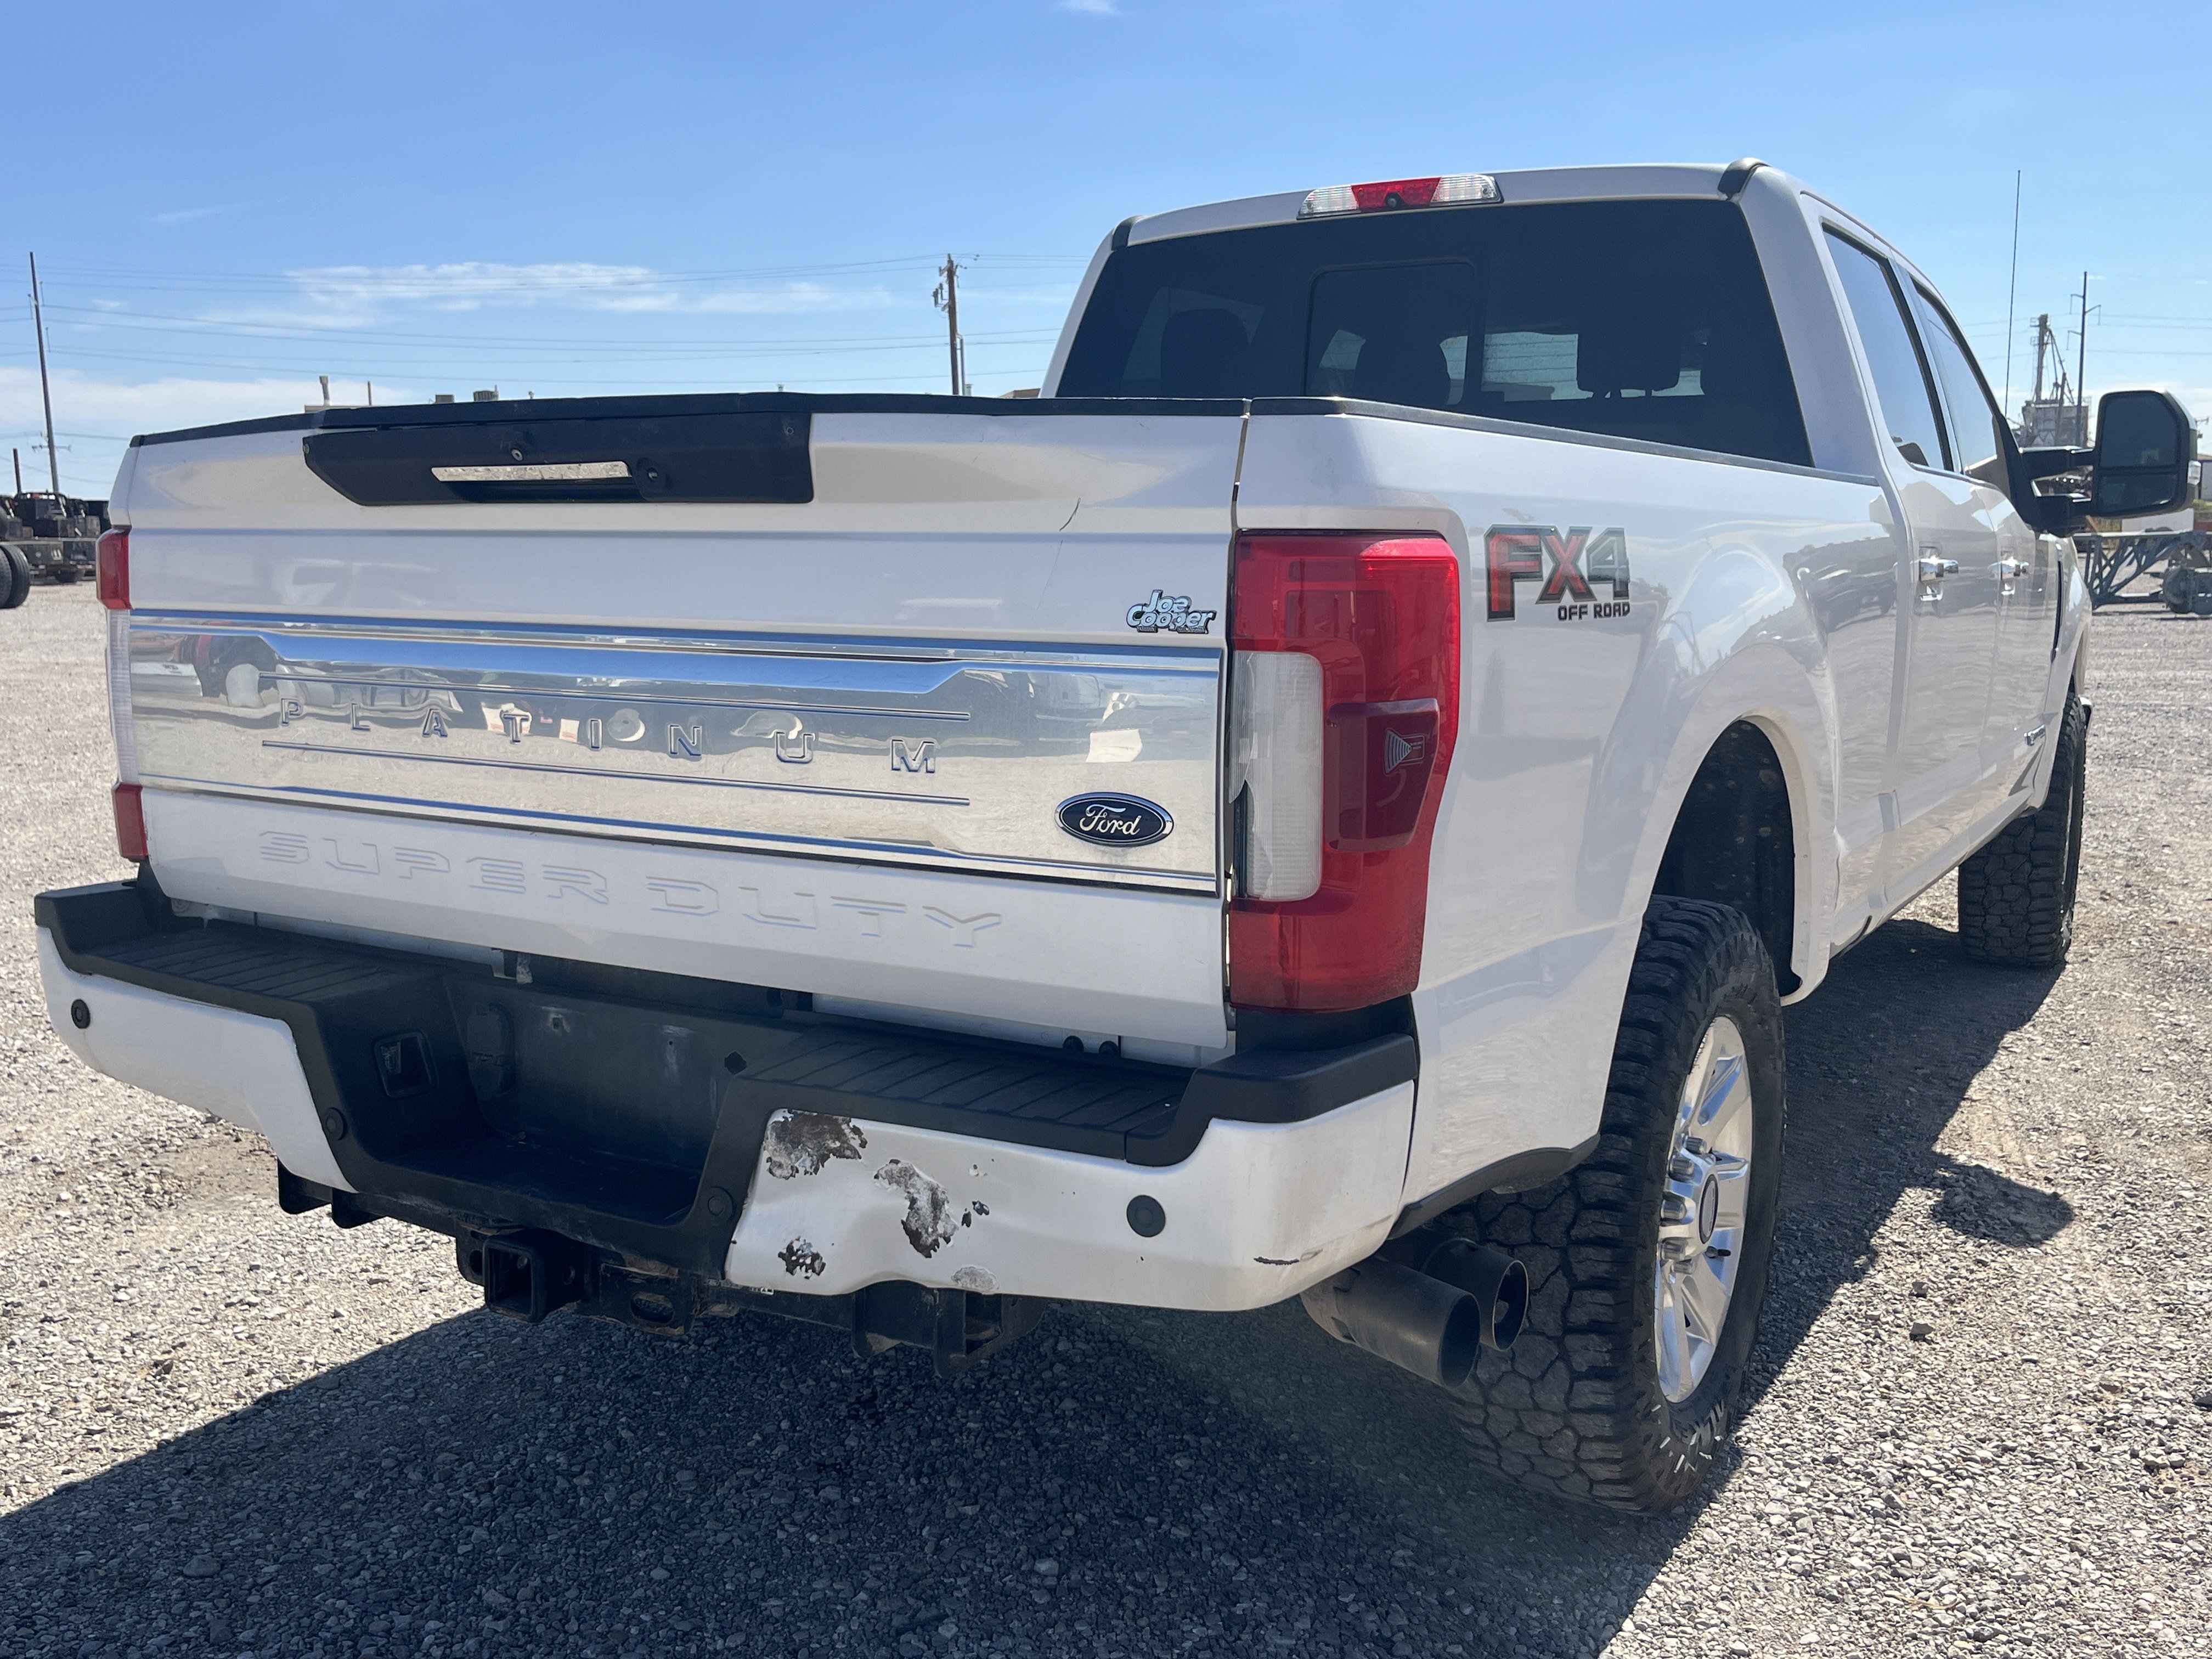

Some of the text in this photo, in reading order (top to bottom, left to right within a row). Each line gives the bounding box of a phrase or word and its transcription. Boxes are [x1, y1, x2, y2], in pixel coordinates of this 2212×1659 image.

[1484, 524, 1630, 622] FX4
[1126, 603, 1217, 631] Cooper
[1143, 589, 1192, 613] Joe
[1558, 601, 1630, 621] OFF ROAD
[281, 698, 936, 774] PLATINUM
[1079, 803, 1142, 836] Ford
[259, 830, 1003, 948] SUPER DUTY
